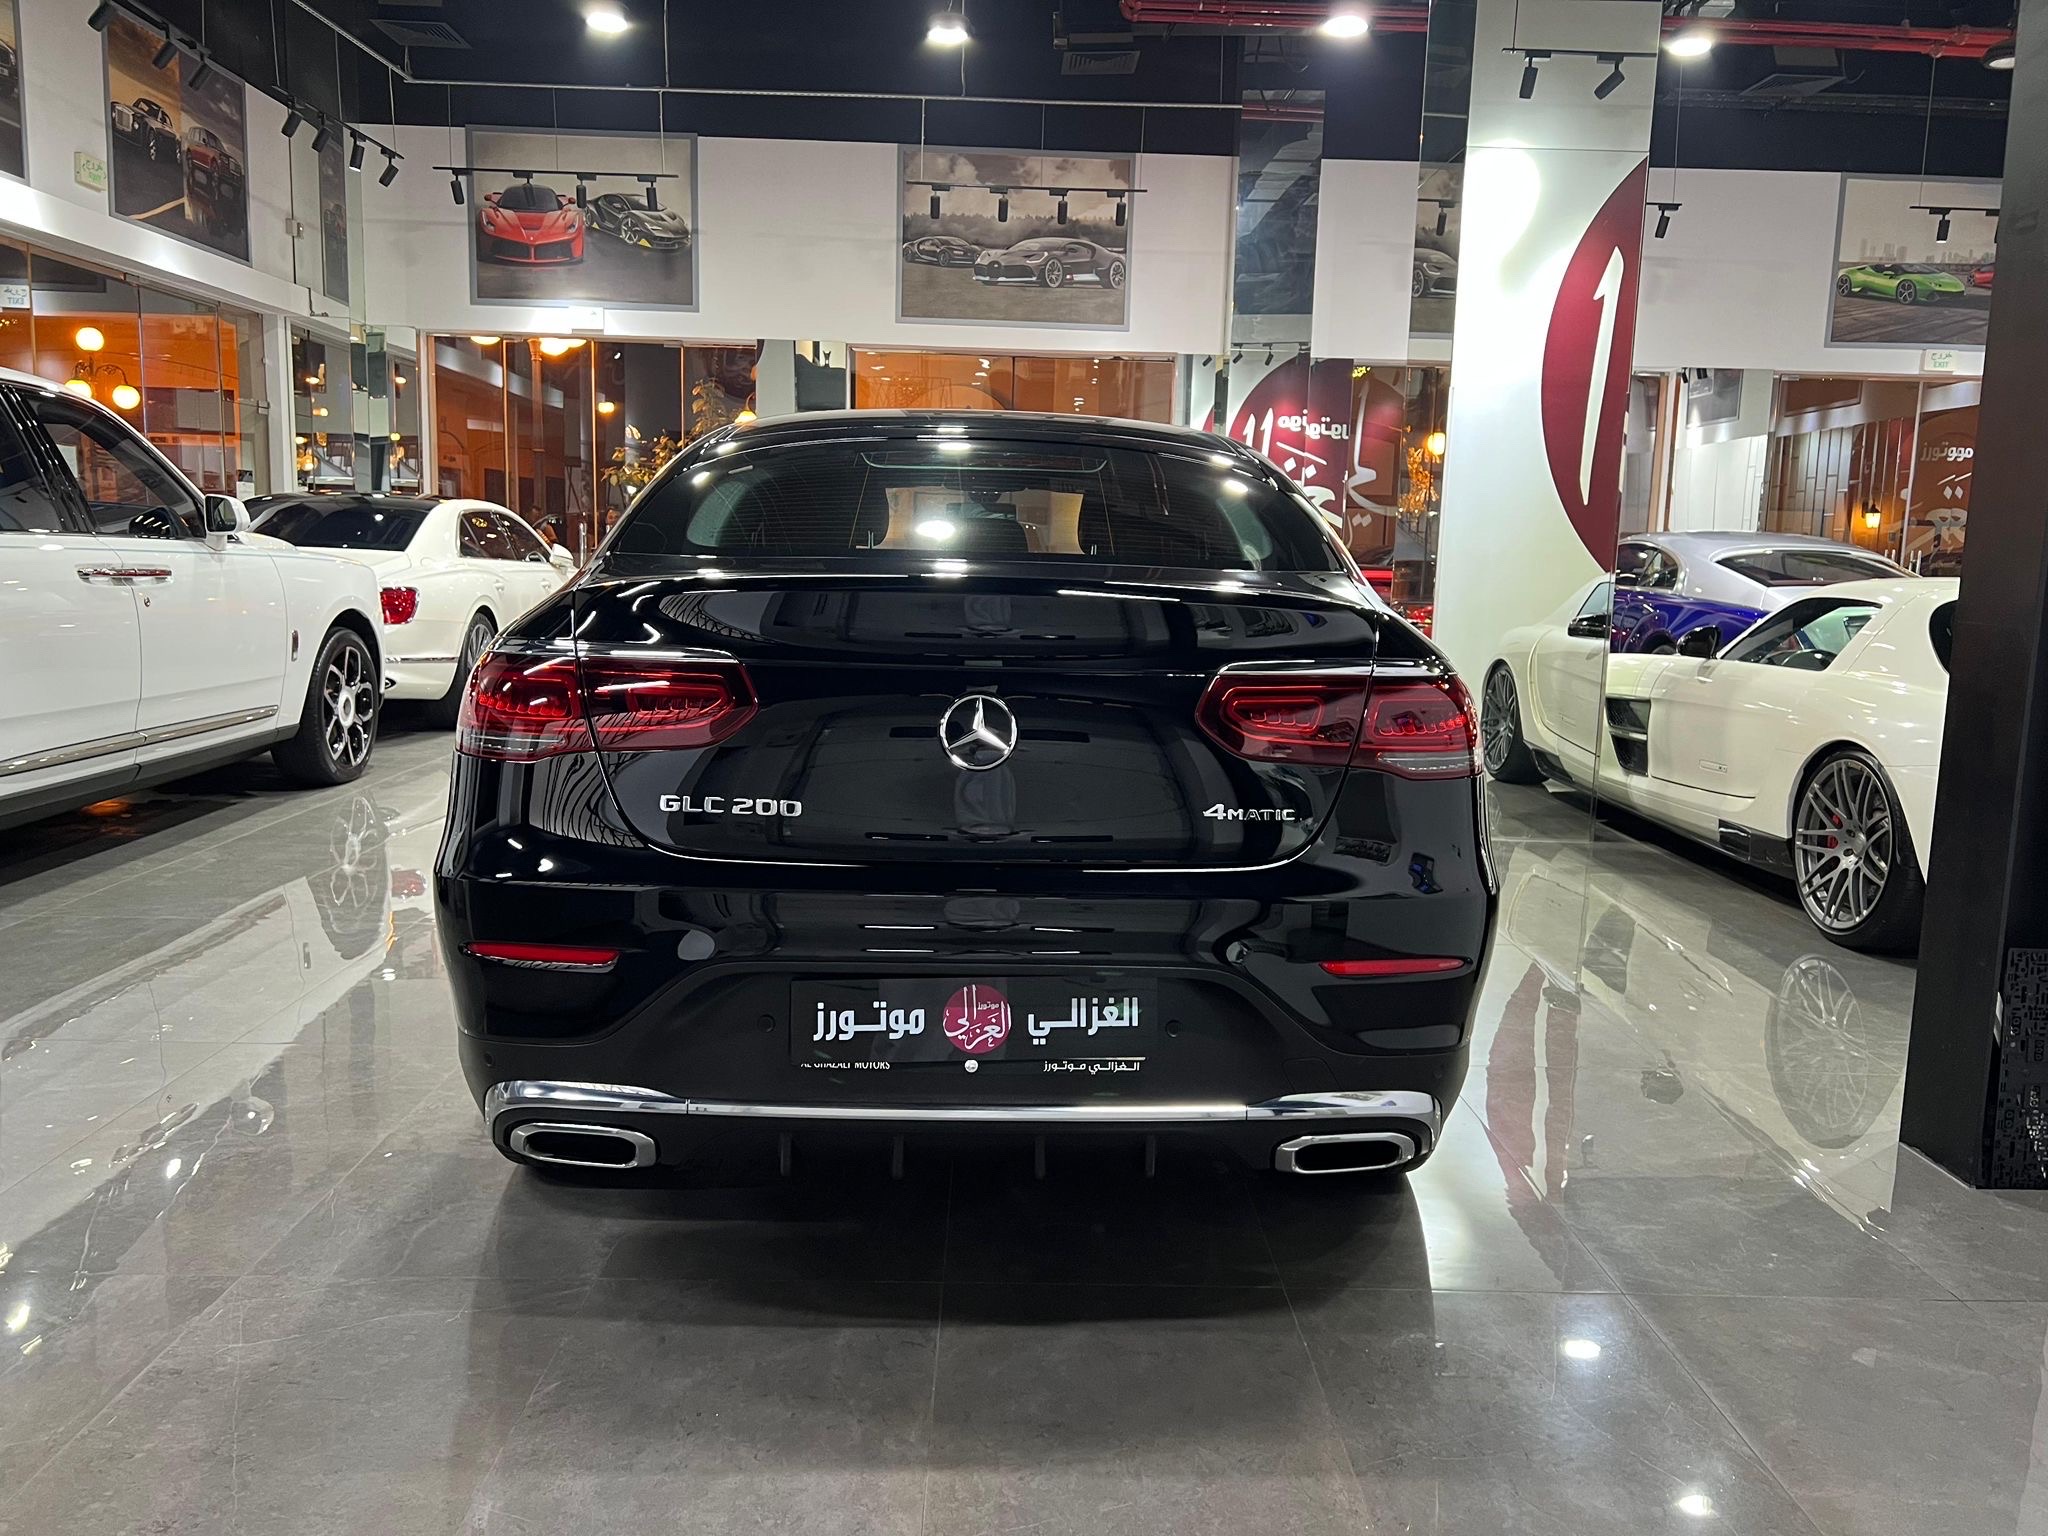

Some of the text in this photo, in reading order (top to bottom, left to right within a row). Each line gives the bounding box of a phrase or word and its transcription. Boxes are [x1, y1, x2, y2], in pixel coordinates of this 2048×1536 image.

[659, 794, 802, 817] GLC 200
[1202, 803, 1296, 821] 4MATIC
[813, 996, 1139, 1046] الغزالي موتورز
[1043, 1060, 1140, 1075] الغزالي موتورز
